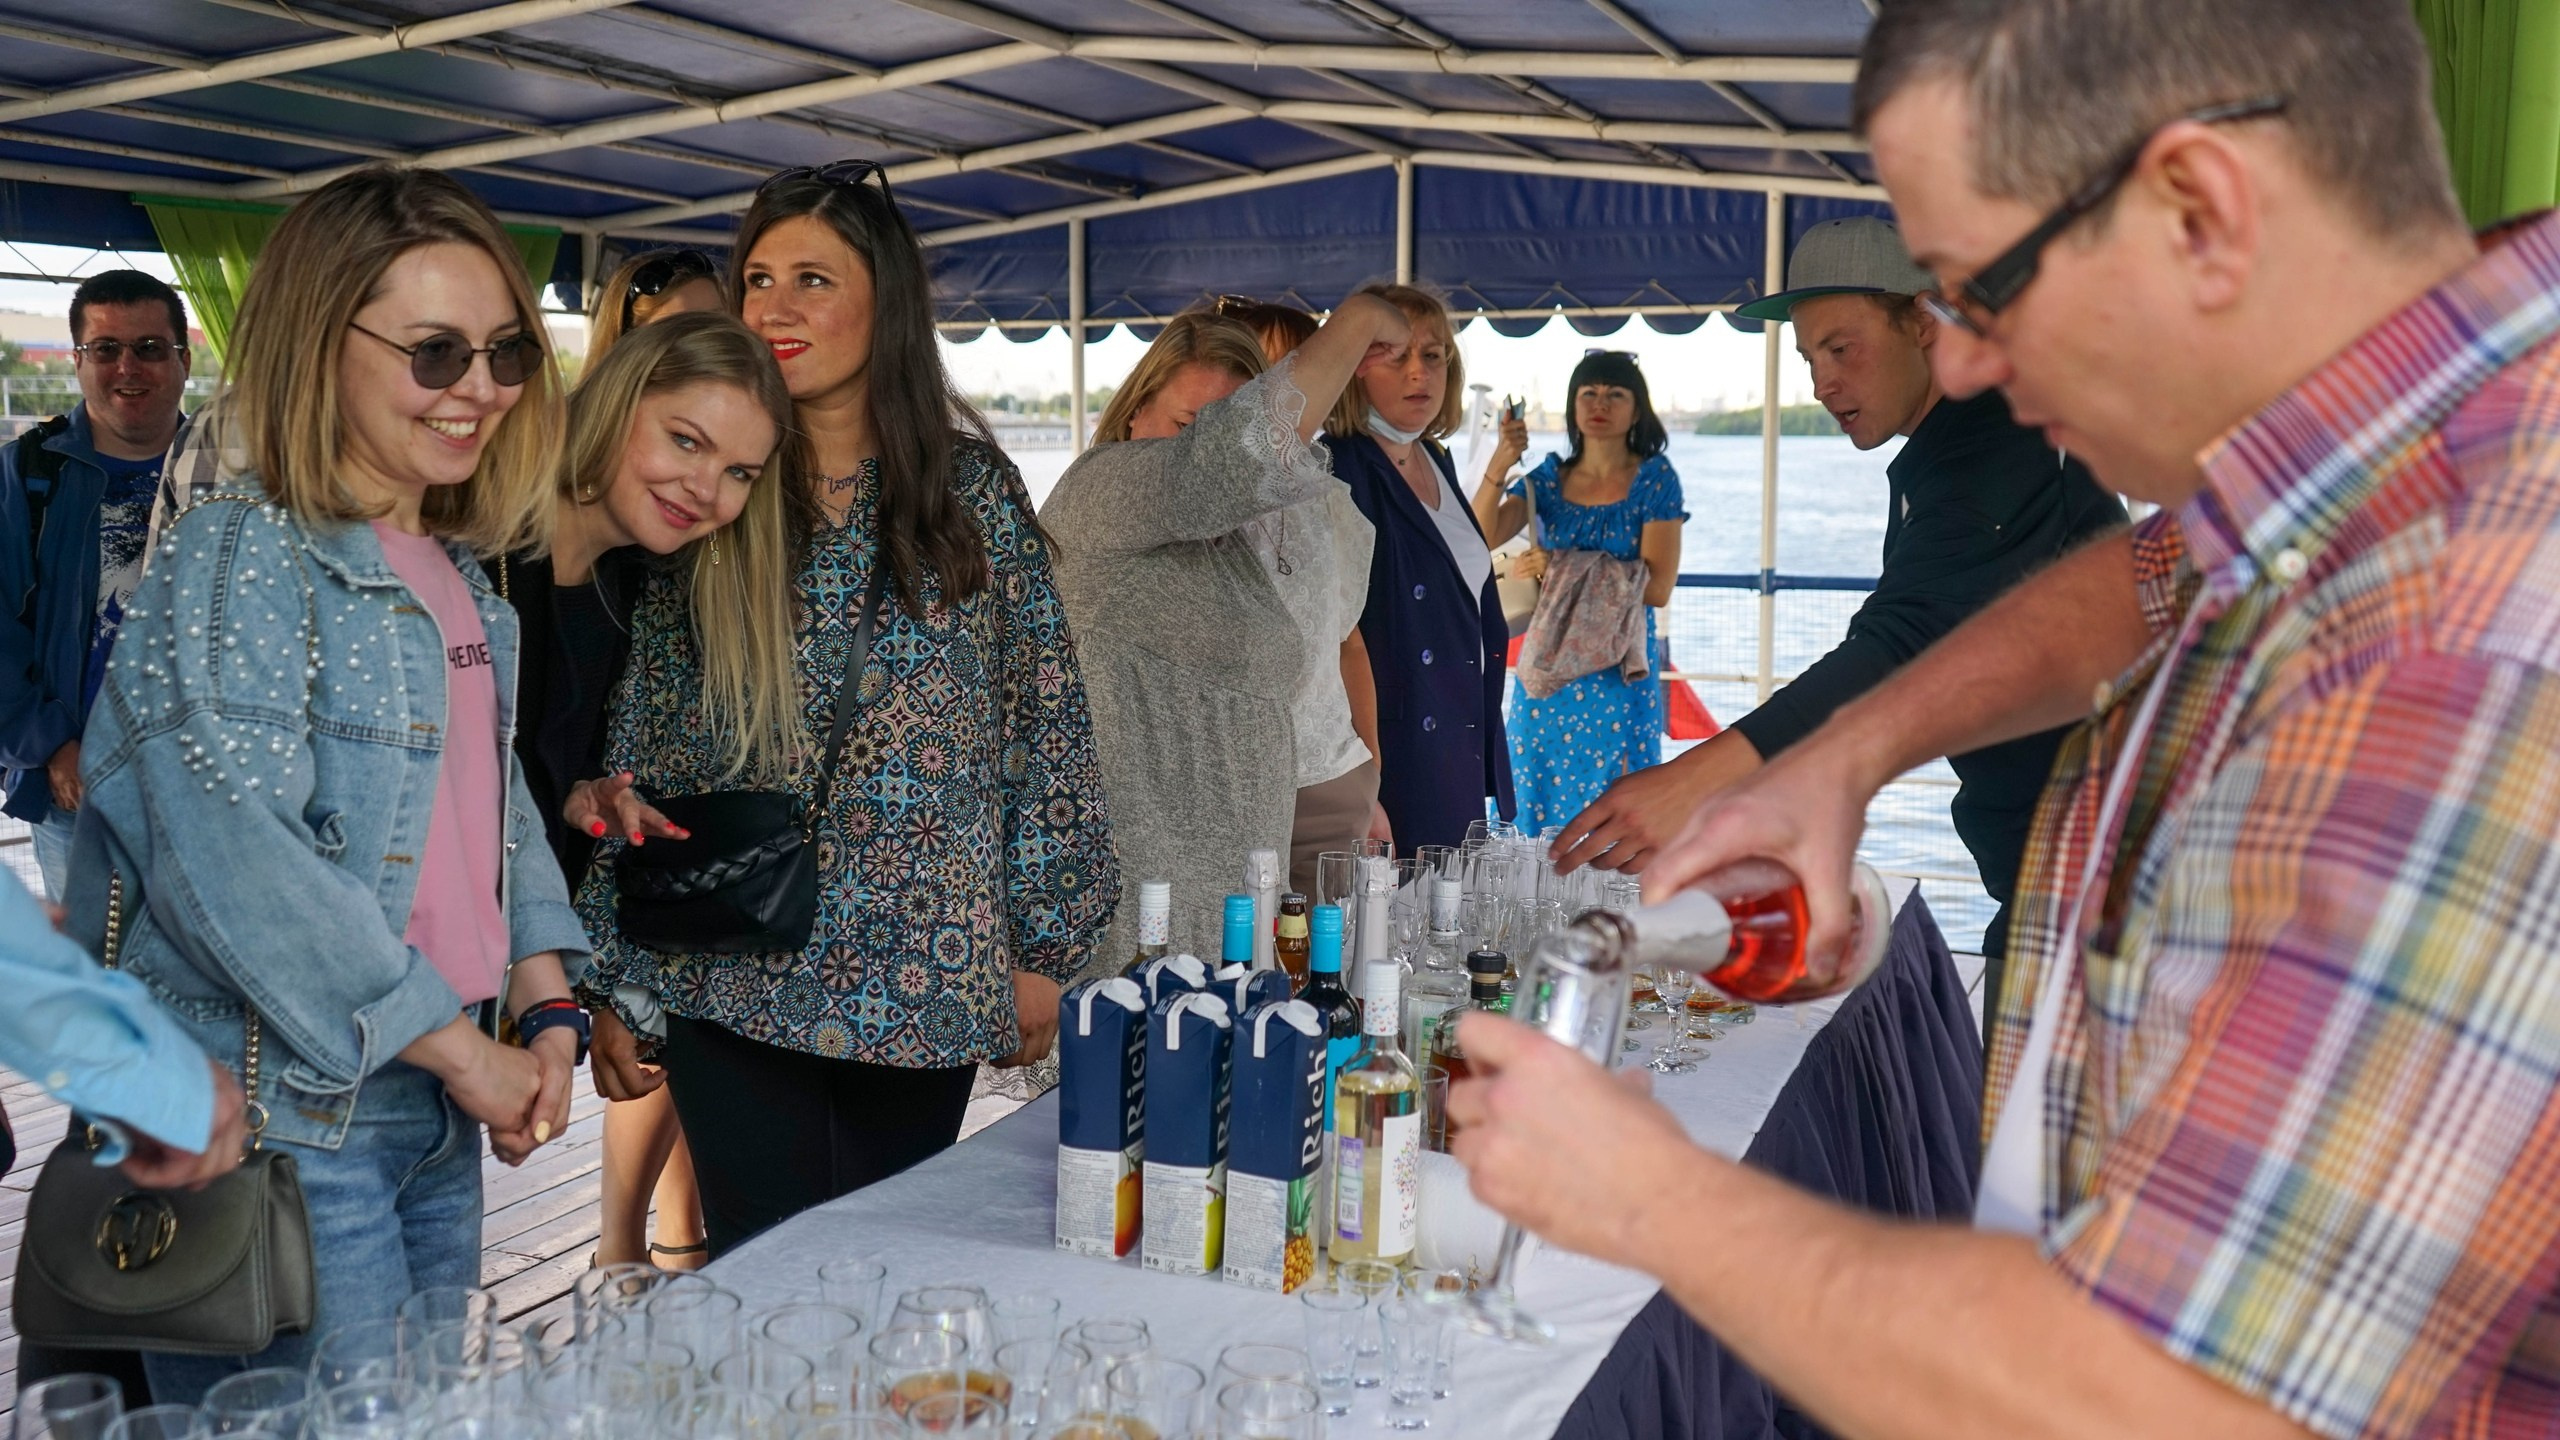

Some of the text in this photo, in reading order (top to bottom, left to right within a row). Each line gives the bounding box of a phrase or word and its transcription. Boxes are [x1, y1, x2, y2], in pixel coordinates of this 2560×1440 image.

[448, 643, 492, 670] ЧЕЛЕ
[1126, 1024, 1147, 1139] Rich
[1302, 1049, 1327, 1168] Rich
